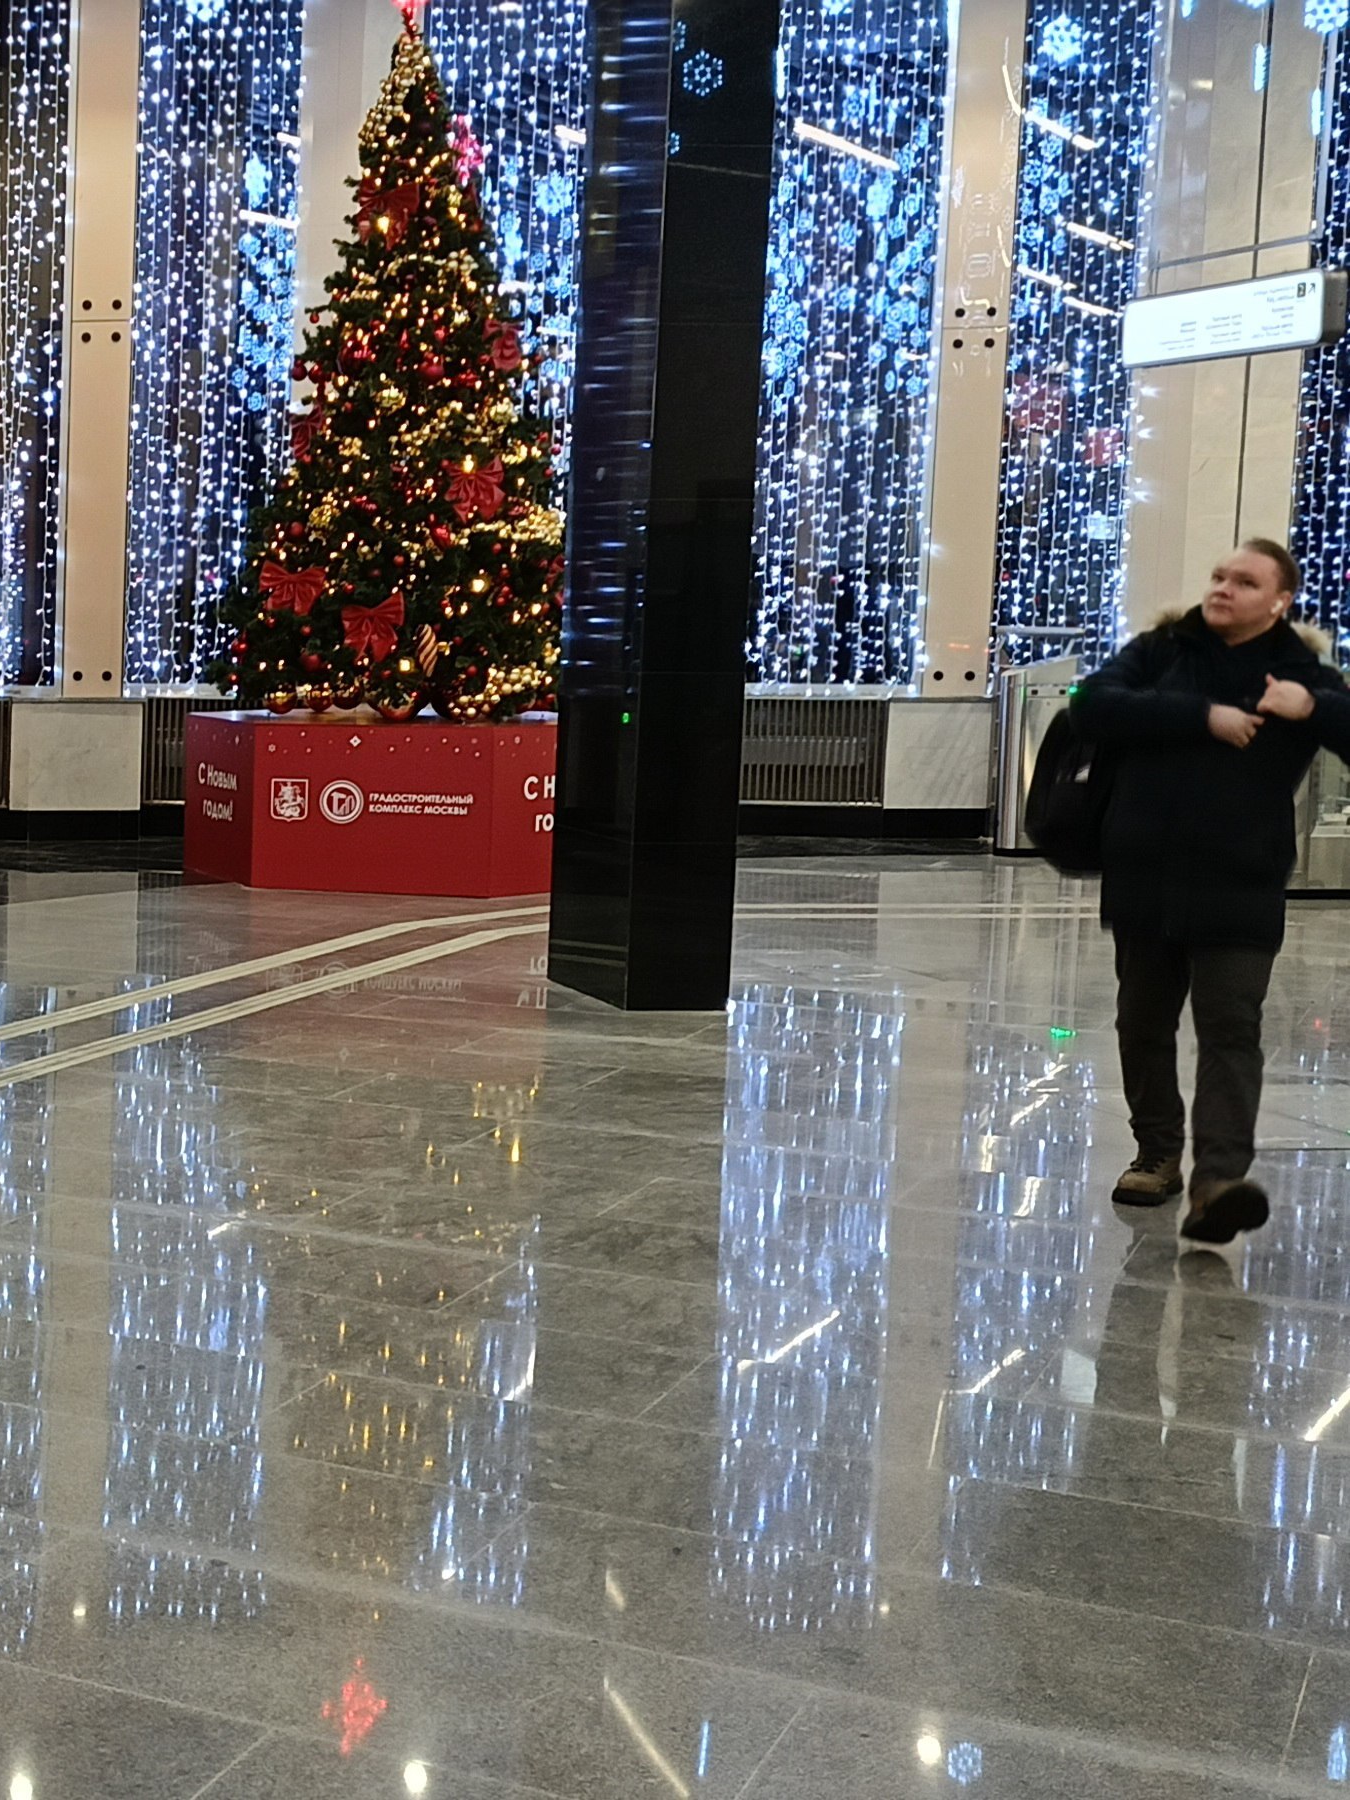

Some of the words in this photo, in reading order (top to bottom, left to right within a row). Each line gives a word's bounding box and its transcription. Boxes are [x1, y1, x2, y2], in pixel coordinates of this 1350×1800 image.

[198, 762, 206, 784] С
[207, 764, 238, 791] Новым
[523, 775, 539, 800] С
[203, 799, 234, 822] годом!
[369, 793, 474, 805] ГРАДОСТРОИТЕЛЬНЫЙ
[369, 804, 423, 814] КОМПЛЕКС
[424, 806, 468, 816] МОСКВЫ
